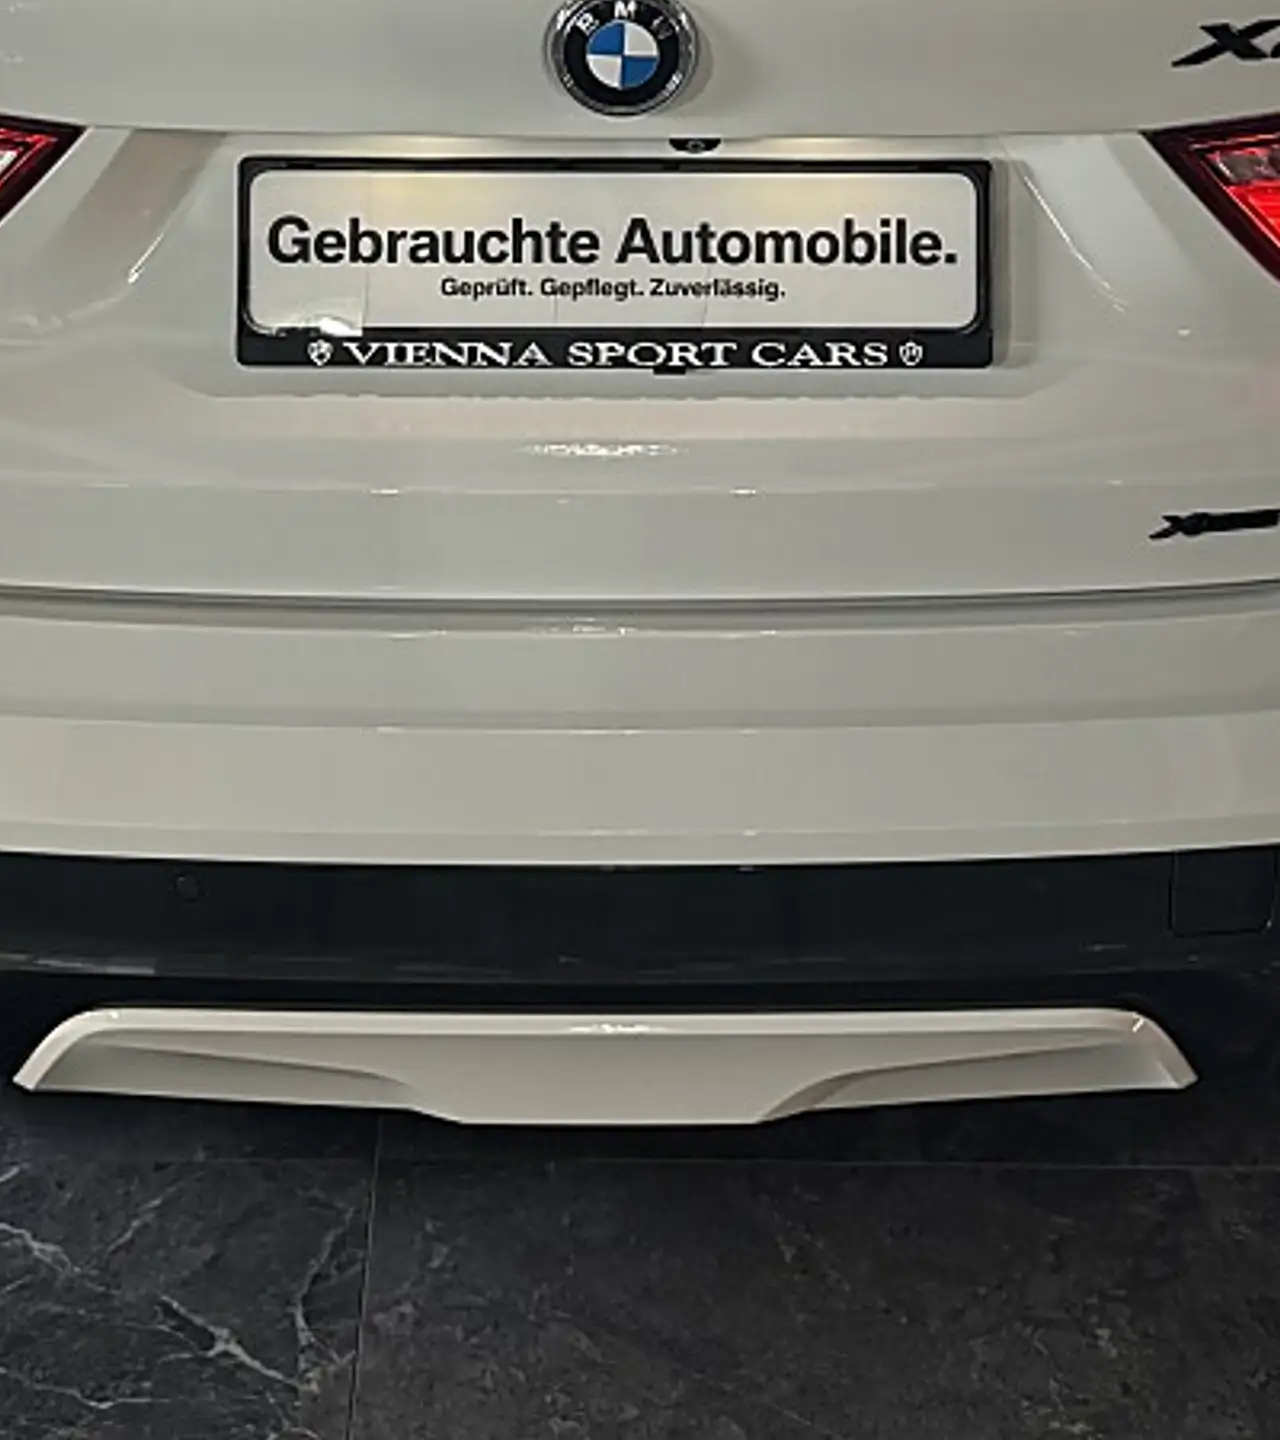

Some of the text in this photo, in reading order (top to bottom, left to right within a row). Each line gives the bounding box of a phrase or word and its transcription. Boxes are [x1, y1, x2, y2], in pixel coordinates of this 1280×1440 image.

[267, 214, 958, 264] Gebrauchte Automobile.
[440, 276, 786, 301] Geprüft. Gepflegt. Zuverlässig.
[342, 340, 889, 367] VIENNA SPORT CARS
